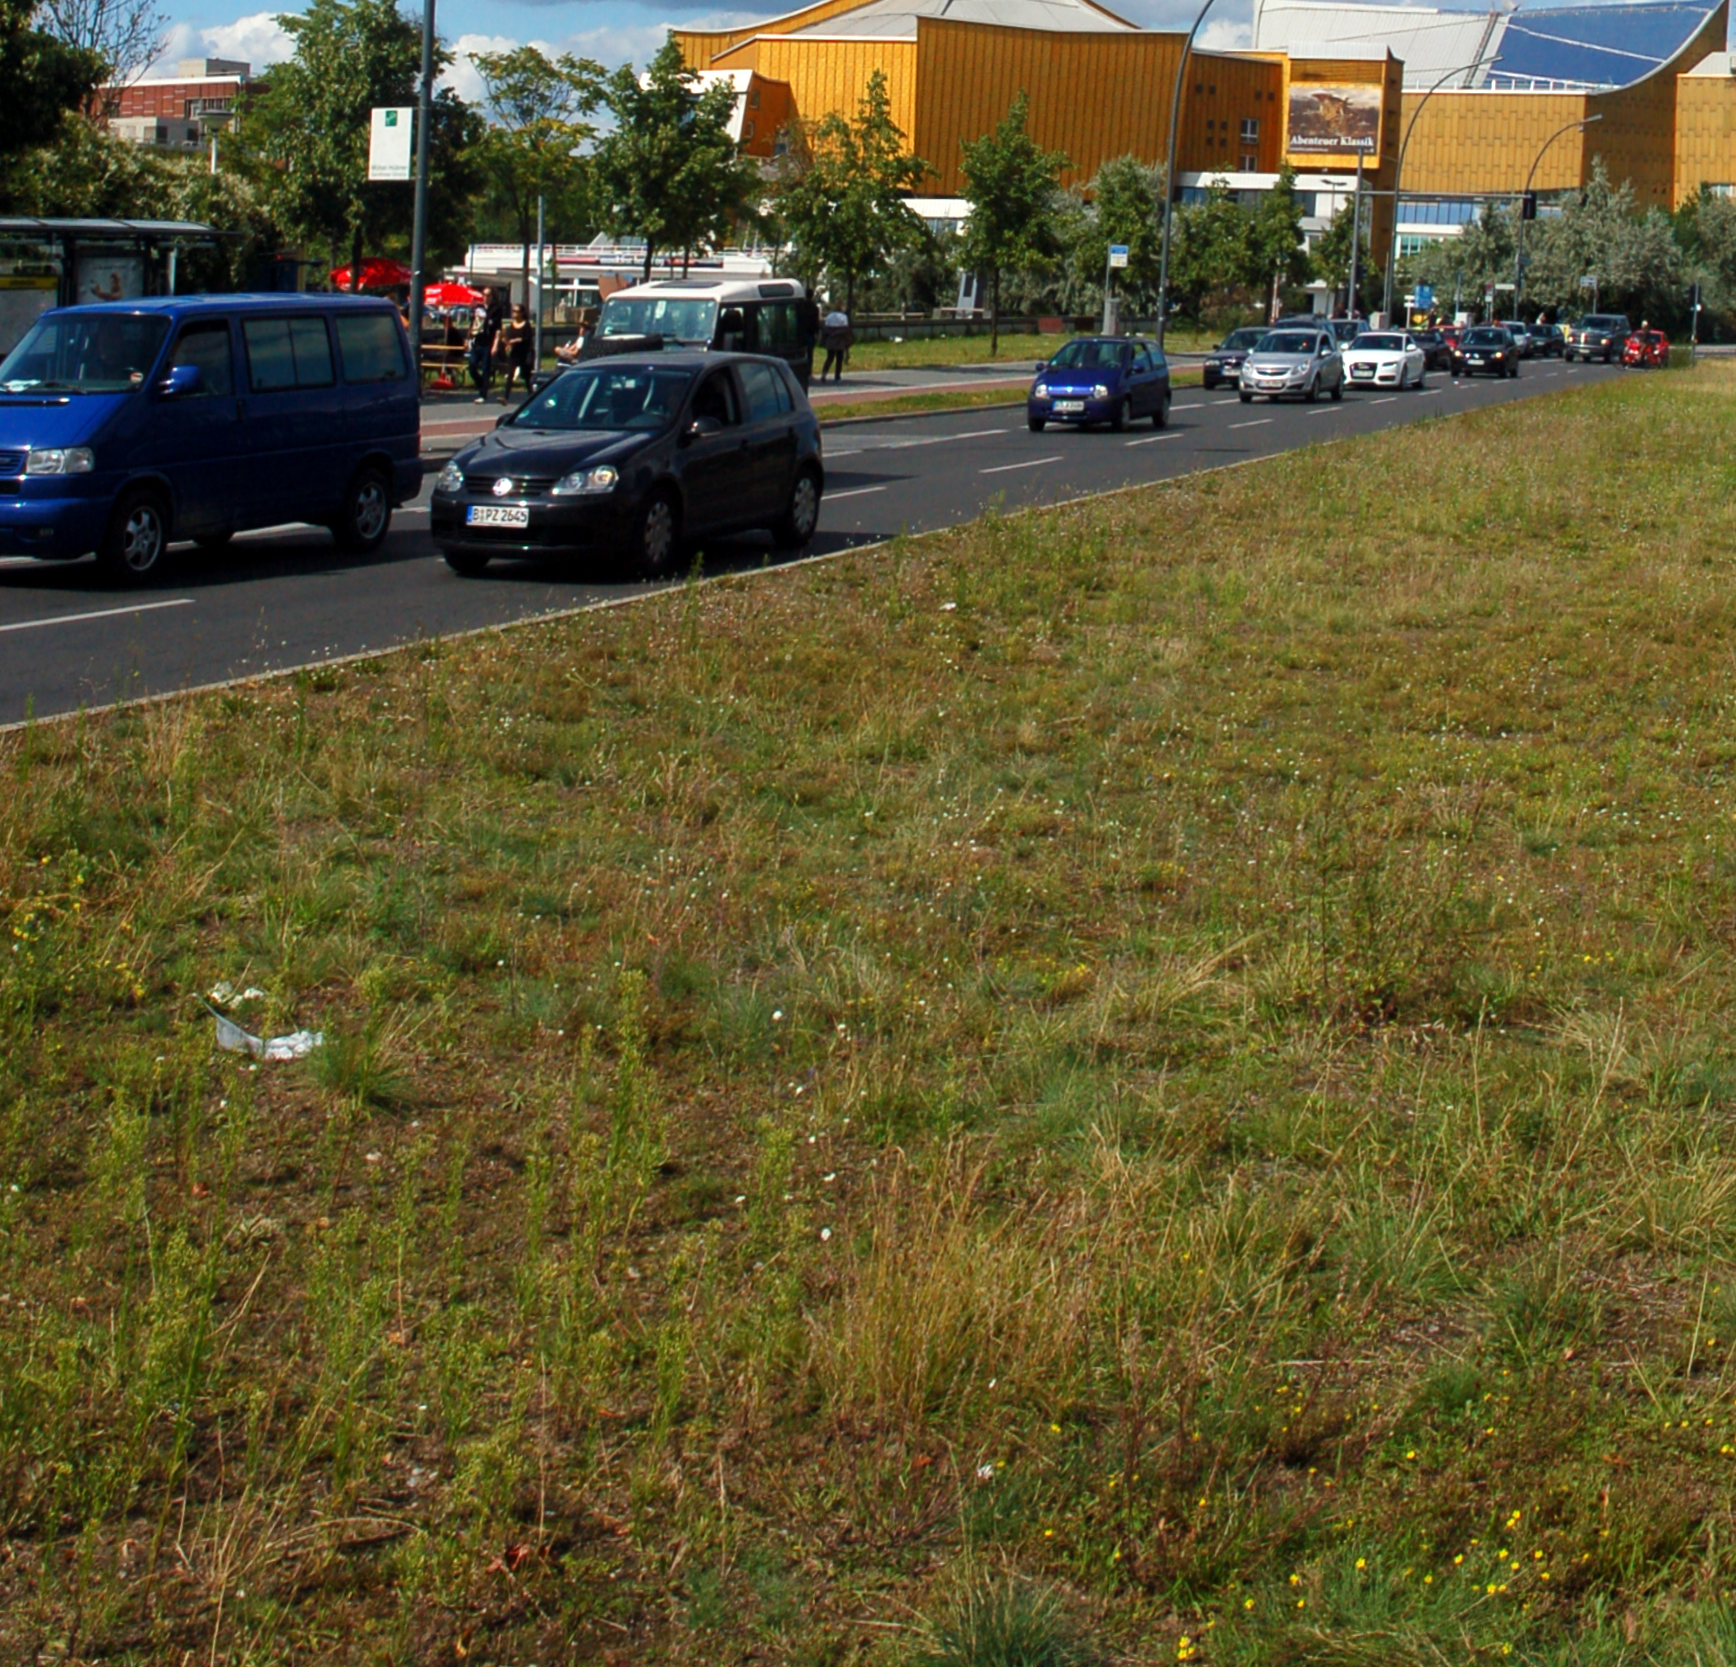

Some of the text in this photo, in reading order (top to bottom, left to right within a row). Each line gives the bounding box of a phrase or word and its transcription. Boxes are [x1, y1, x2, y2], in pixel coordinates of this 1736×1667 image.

[1290, 135, 1374, 146] Abenteuer Klassik
[473, 508, 480, 521] B
[486, 509, 499, 521] PZ
